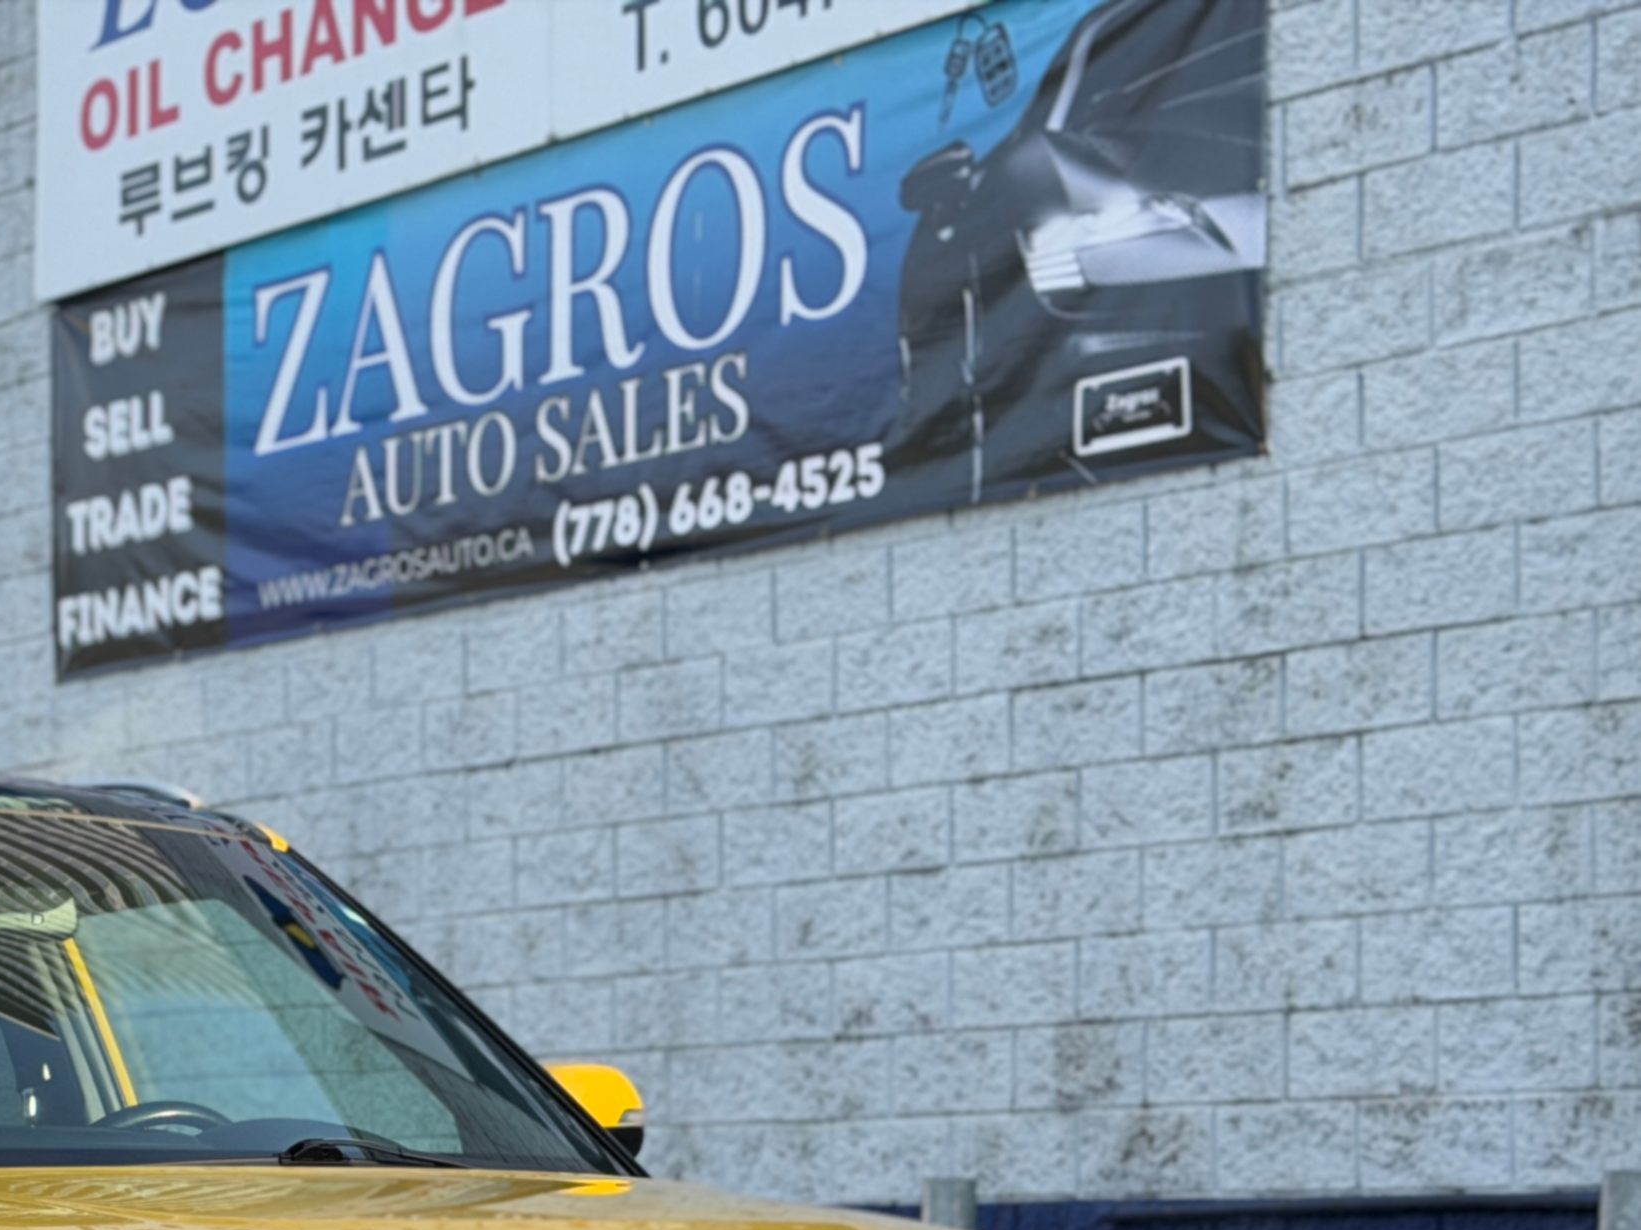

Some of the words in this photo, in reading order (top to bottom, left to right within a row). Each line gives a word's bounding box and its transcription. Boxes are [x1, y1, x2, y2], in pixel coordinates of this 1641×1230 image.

[79, 58, 180, 151] OIL
[117, 125, 270, 236] 루브킹
[299, 55, 477, 171] 카센타
[252, 102, 870, 457] ZAGROS
[89, 292, 166, 365] BUY
[83, 389, 174, 460] SELL
[339, 408, 518, 527] AUTO
[534, 351, 751, 483] SALES
[66, 476, 194, 554] TRADE
[259, 525, 535, 609] WWW.ZAGROSAUTO.CA
[553, 481, 659, 566] (778)
[669, 444, 886, 535] 668-4525
[58, 565, 224, 647] FINANCE
